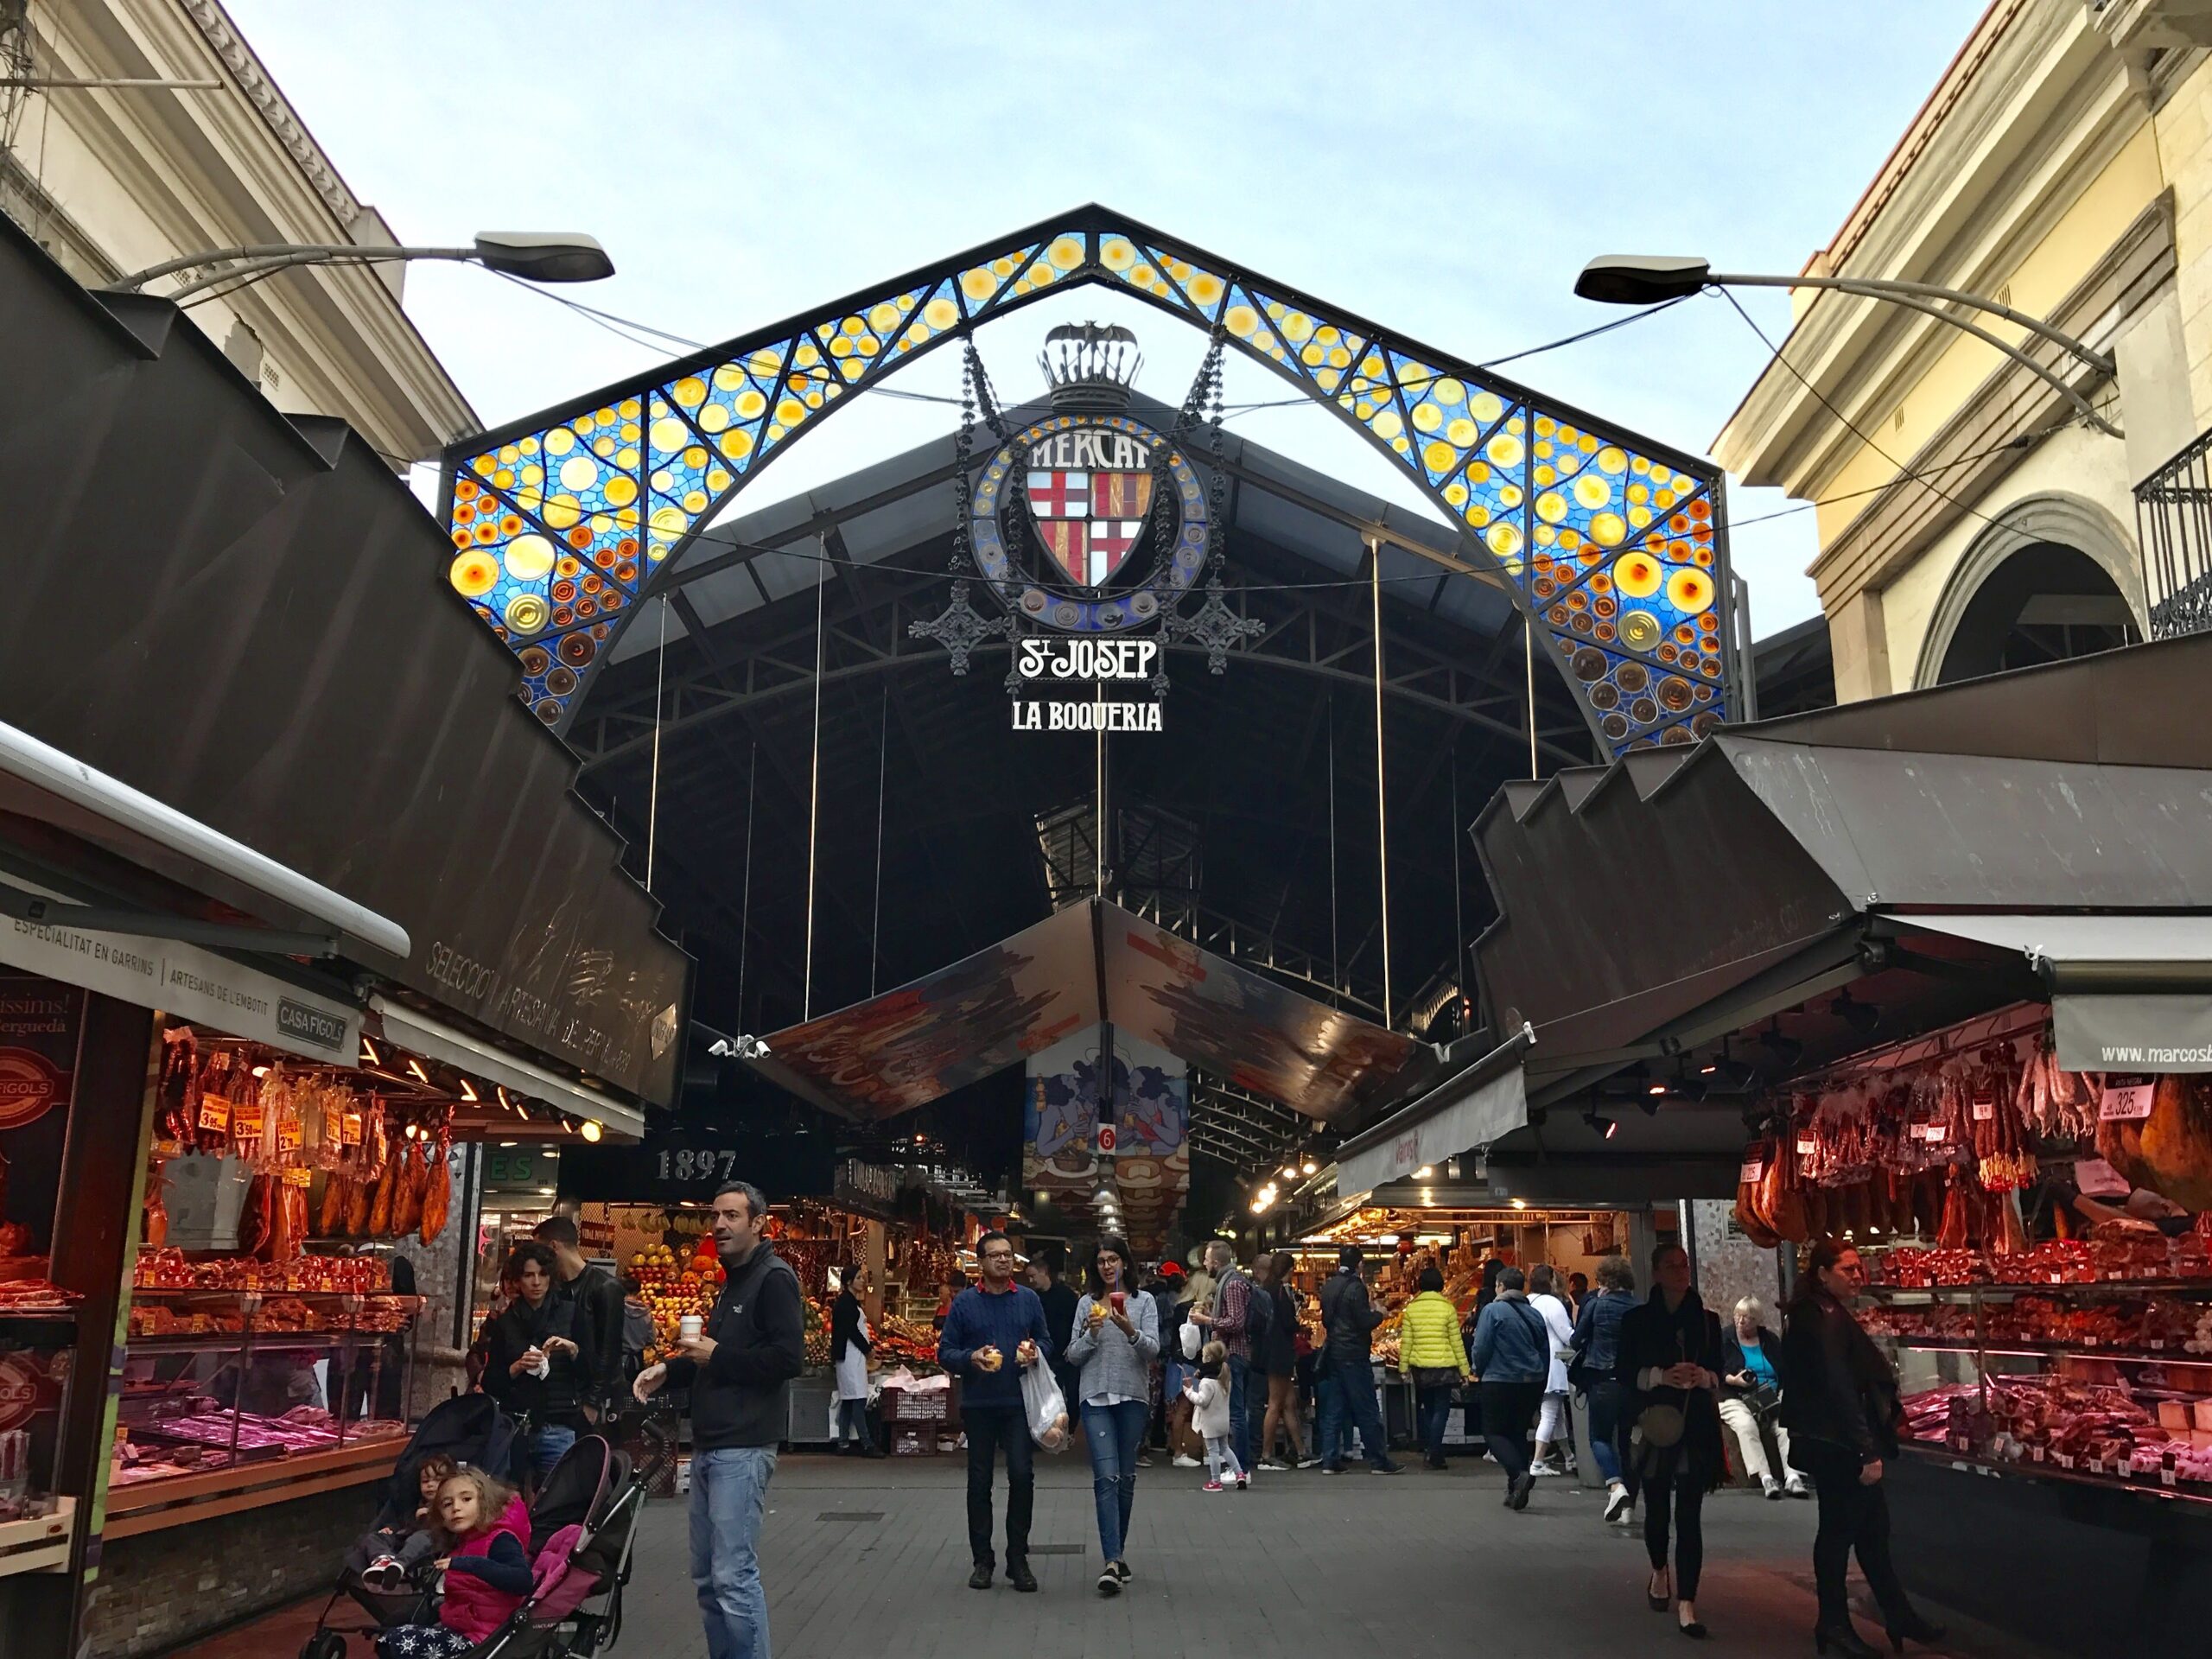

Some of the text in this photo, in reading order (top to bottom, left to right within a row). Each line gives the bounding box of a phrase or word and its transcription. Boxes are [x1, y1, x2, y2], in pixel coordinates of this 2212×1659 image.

[1032, 429, 1150, 468] MERCAT
[1051, 640, 1157, 678] JOSEP
[1013, 702, 1162, 731] LA BOQUERIA
[14, 919, 153, 976] ESPECIALITAT EN GARRINS
[169, 969, 214, 997] ARTESANS
[217, 986, 227, 1001] DE
[280, 1006, 308, 1032] CASA
[2115, 1091, 2136, 1116] 325
[1103, 1132, 1111, 1147] 6
[489, 1156, 533, 1181] ES
[656, 1149, 737, 1180] 1897
